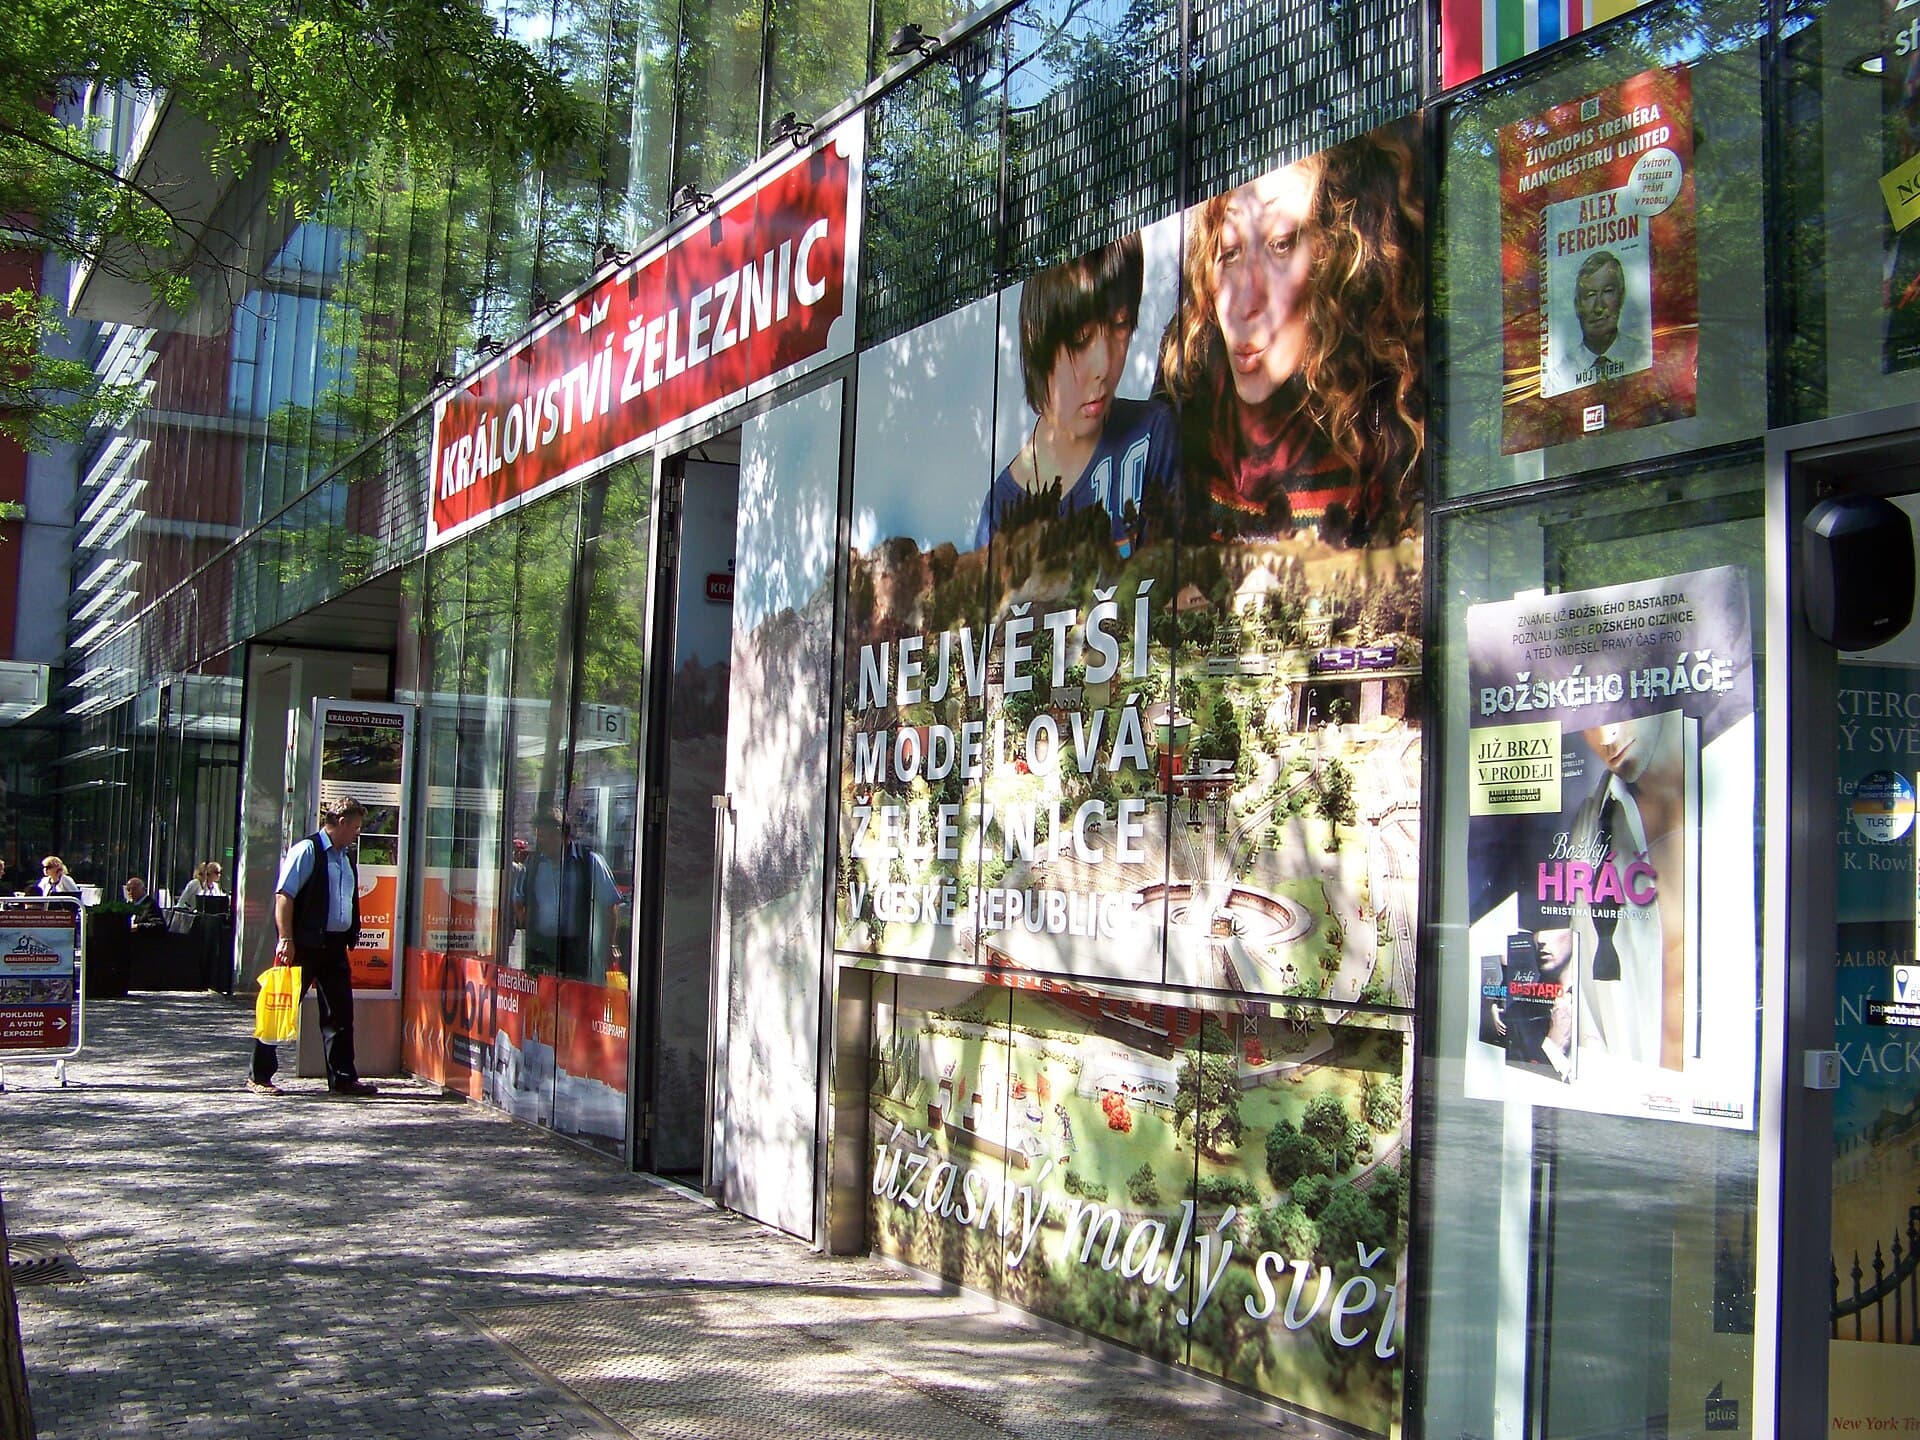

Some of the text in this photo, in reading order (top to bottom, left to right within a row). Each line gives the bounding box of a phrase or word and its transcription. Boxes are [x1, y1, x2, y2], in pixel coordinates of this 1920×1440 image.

[1526, 104, 1661, 167] ŽIVOTOPIS TRENÉRA
[1518, 126, 1670, 194] MANCHESTERU UNITED
[1578, 192, 1618, 225] ALEX
[1557, 215, 1640, 257] FERGUSON
[440, 218, 829, 501] KRÁLOVSTVÍ ŽELEZNIC
[1568, 600, 1625, 619] BOŽSKÉHO
[1628, 592, 1689, 611] BASTARDA.
[858, 579, 1155, 711] NEJVĚTŠÍ
[1512, 631, 1551, 646] POZNALI
[1554, 628, 1580, 642] JSME
[1588, 615, 1645, 636] BOŽSKÉHO
[1524, 650, 1532, 662] A
[1554, 641, 1599, 657] NADEŠEL
[1636, 631, 1657, 648] ČAS
[1660, 630, 1682, 644] PRO
[1480, 648, 1735, 718] BOŽSKÉHO HRÁČE
[327, 714, 402, 726] KRÁLOVSTVÍ ŽELEZNIC
[854, 692, 1150, 785] MODELOVÁ
[1478, 737, 1552, 760] JIŽ BRZY
[1478, 768, 1487, 781] V
[1491, 763, 1553, 782] PRODEJI
[851, 796, 1146, 865] ŽELEZNICE
[1866, 815, 1898, 828] TLAČIT
[1549, 829, 1612, 869] Božský
[1537, 851, 1658, 907] HRÁČ
[850, 882, 867, 919] V
[1541, 905, 1589, 918] CHRISTINA
[497, 994, 520, 1015] model
[1509, 980, 1564, 998] BASTARD
[1886, 1016, 1907, 1026] SOLD
[872, 1118, 1053, 1268] úžasný
[1061, 1200, 1236, 1327] malý
[1708, 1409, 1737, 1423] plus
[1832, 1416, 1862, 1431] New
[1865, 1416, 1900, 1431] York
